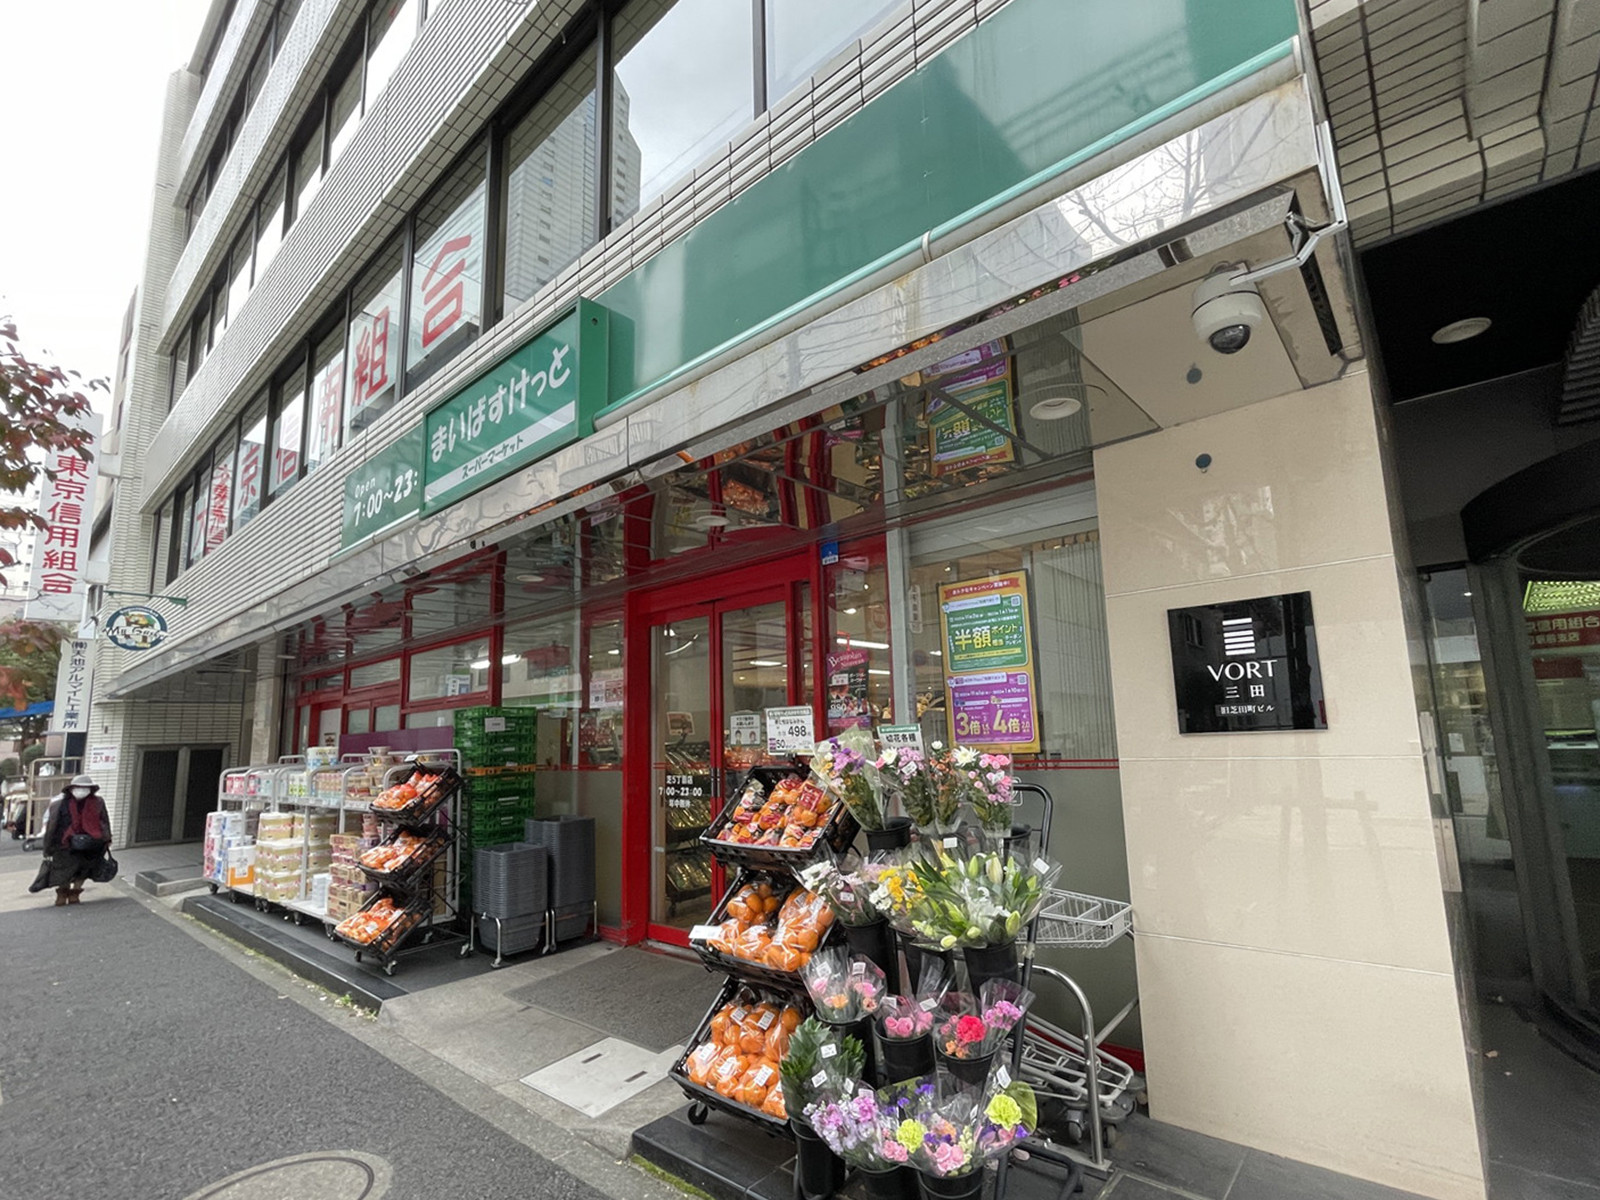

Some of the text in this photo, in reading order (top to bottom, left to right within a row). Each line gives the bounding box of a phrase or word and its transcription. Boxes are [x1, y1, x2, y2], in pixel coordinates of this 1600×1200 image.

[430, 344, 571, 463] まいばすけっと
[462, 435, 524, 479] スーパーマーケット
[354, 477, 376, 498] Open
[41, 454, 90, 594] 東京信用組合
[954, 625, 992, 651] 半額
[991, 623, 1018, 634] ポイント
[1206, 659, 1278, 682] VORT
[1225, 684, 1265, 698] 三田
[788, 725, 807, 737] 498
[658, 786, 703, 797] 700~23:00
